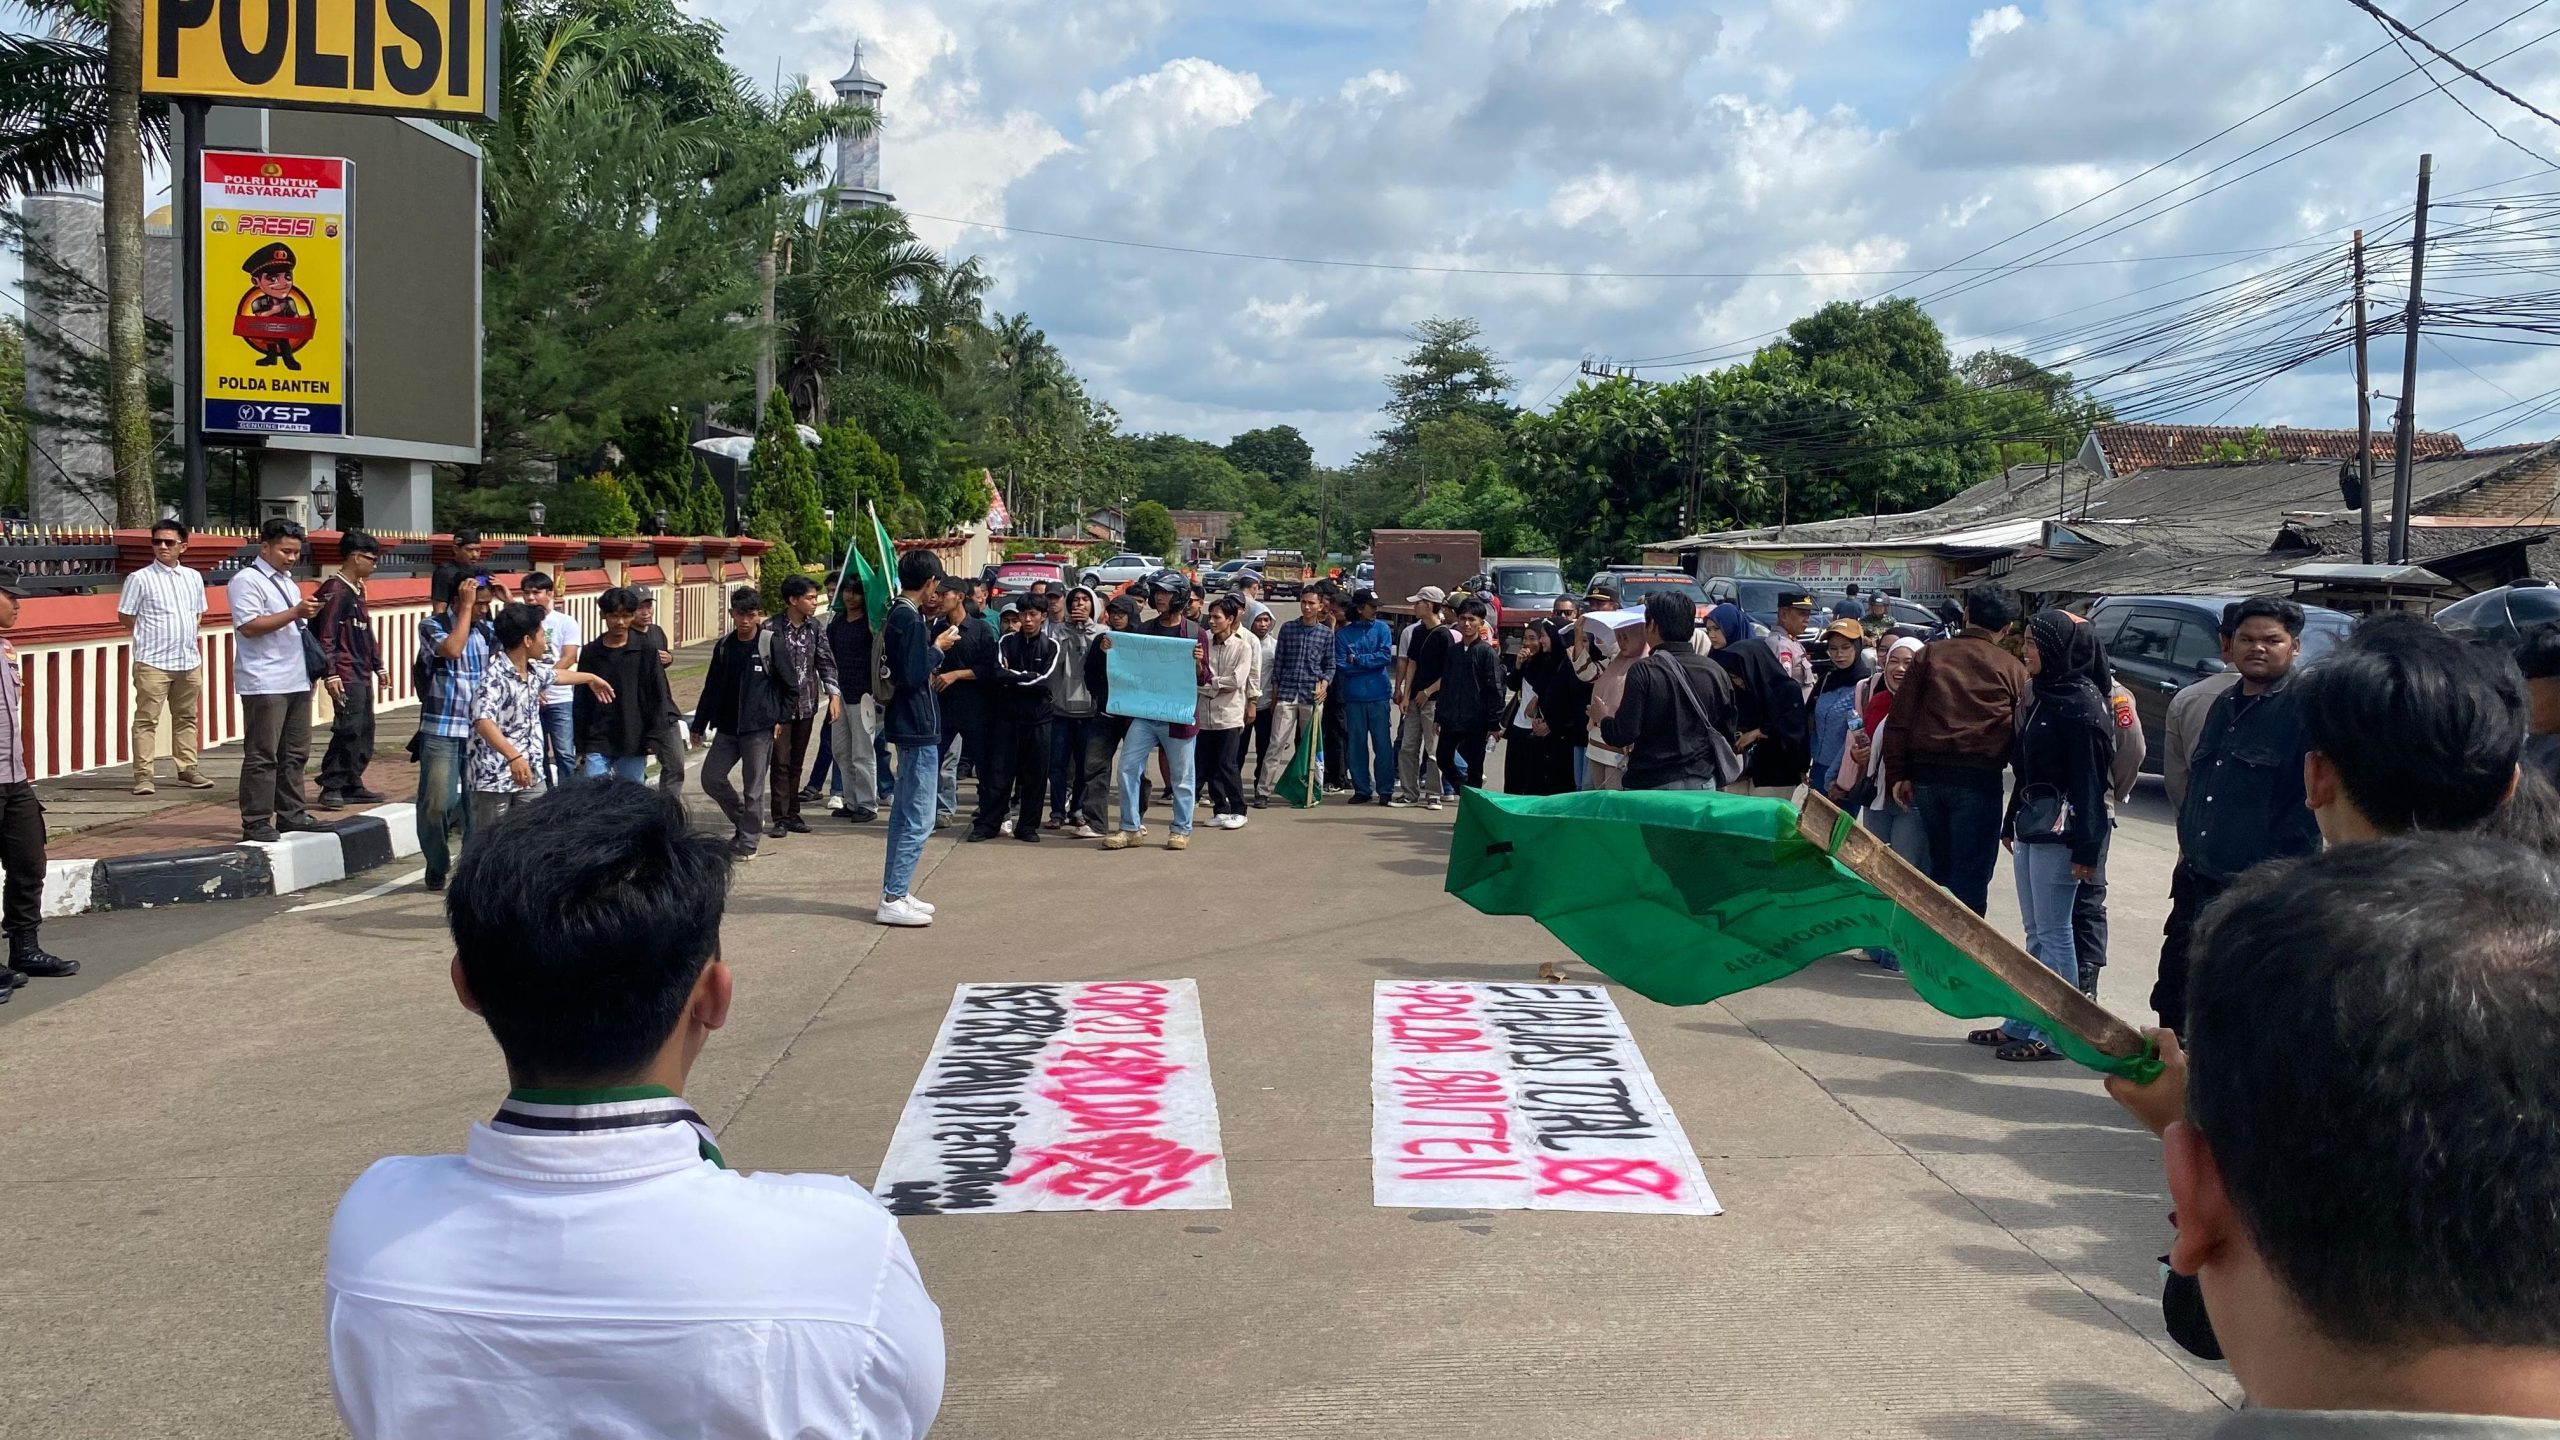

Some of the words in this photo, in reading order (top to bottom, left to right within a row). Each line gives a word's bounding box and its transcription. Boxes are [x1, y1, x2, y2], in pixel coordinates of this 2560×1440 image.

[157, 0, 470, 97] POLISI
[224, 175, 265, 186] POLRI
[270, 178, 319, 188] UNTUK
[225, 185, 318, 199] MASYARAKAT
[237, 214, 316, 238] PRESISI
[219, 377, 267, 391] POLDA
[271, 379, 330, 394] BANTEN
[255, 406, 310, 422] YSP
[239, 422, 277, 430] GENUINE
[1774, 558, 1891, 577] SETIA
[1071, 981, 1170, 1038] COPOT
[1482, 985, 1626, 1072] EVALUASI
[1391, 1066, 1530, 1181] BANTEN
[1517, 1077, 1658, 1151] TOTAL
